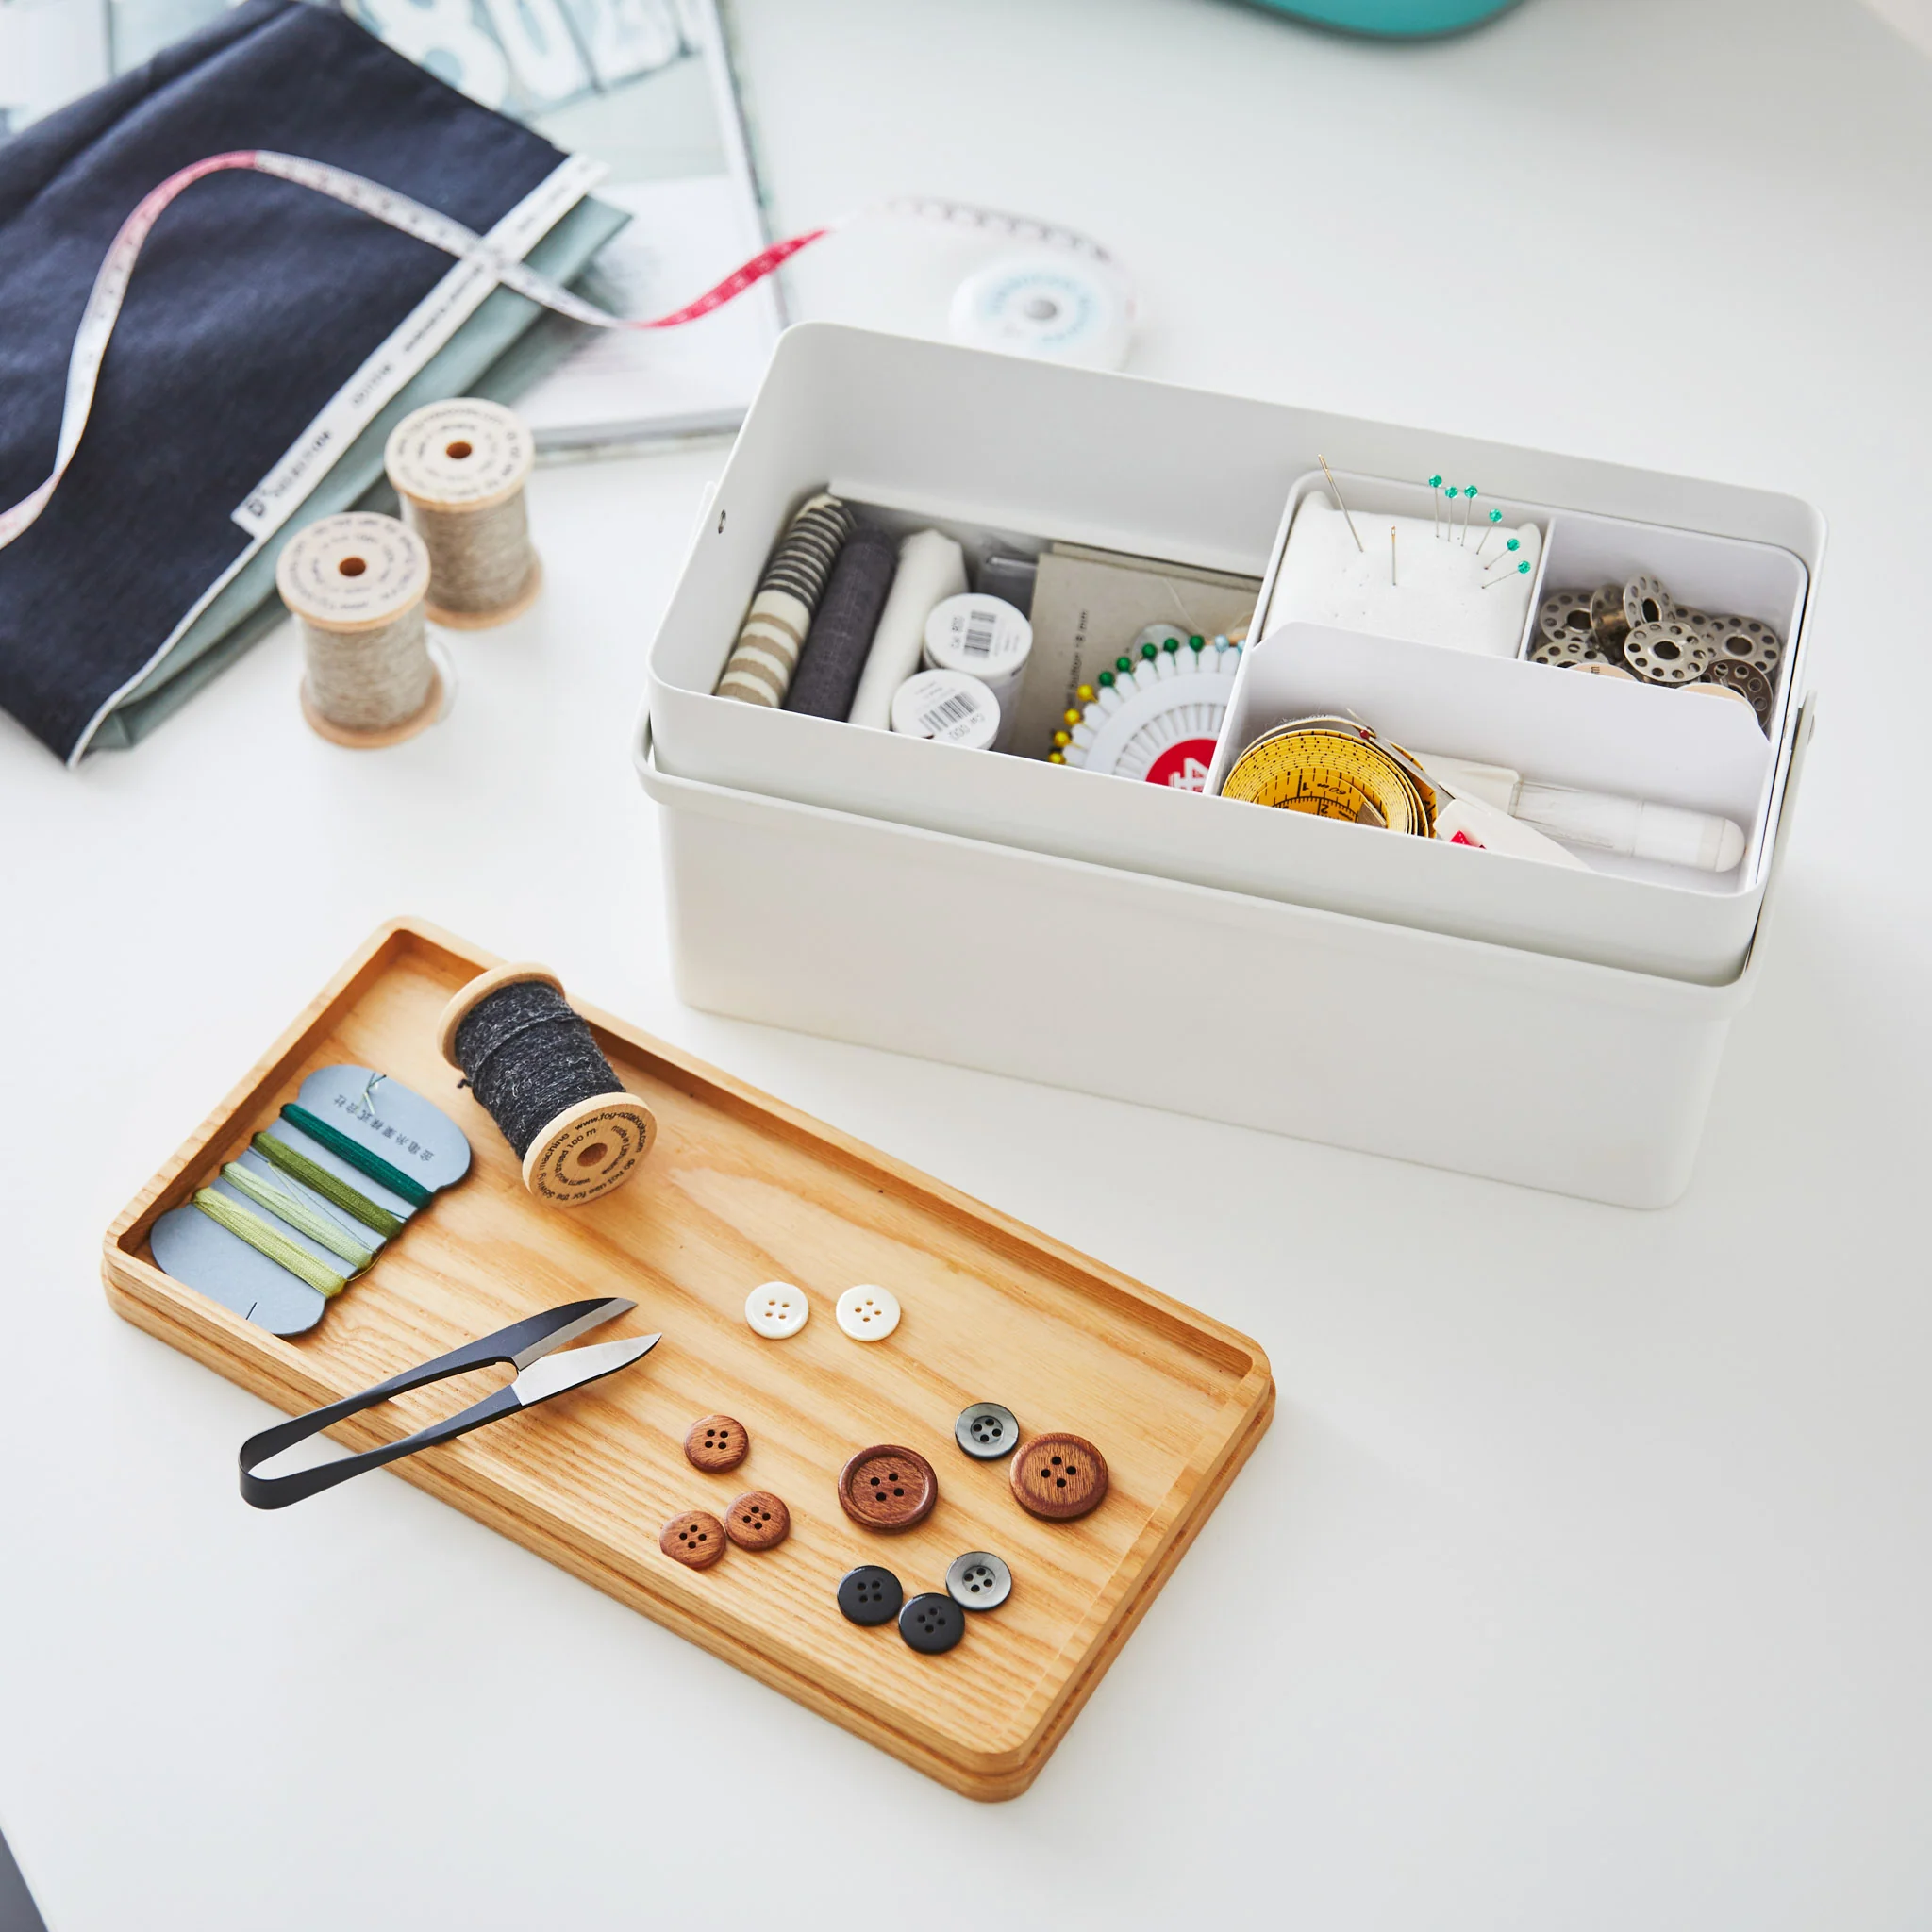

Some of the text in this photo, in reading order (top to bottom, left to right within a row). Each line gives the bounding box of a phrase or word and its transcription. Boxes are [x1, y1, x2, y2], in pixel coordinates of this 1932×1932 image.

[1321, 804, 1329, 814] 2
[567, 1135, 584, 1148] 100
[586, 1127, 596, 1136] m
[539, 1133, 570, 1171] machine
[623, 1158, 635, 1171] do
[607, 1171, 624, 1184] not
[537, 1172, 556, 1199] sewing
[573, 1191, 587, 1199] for
